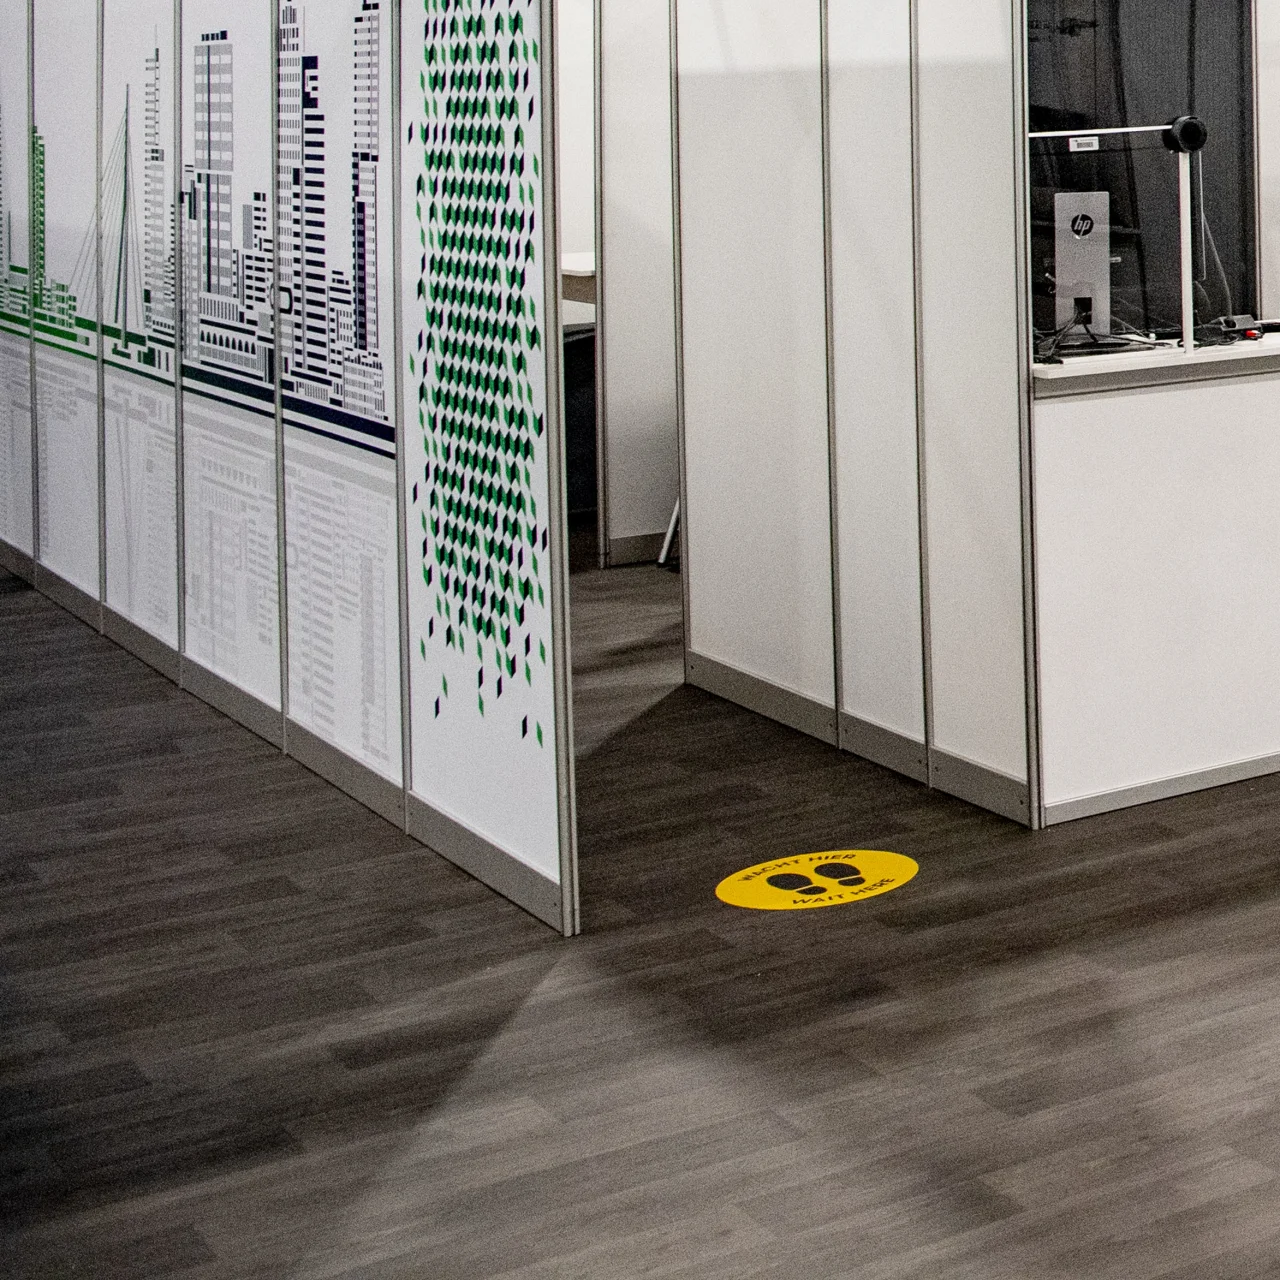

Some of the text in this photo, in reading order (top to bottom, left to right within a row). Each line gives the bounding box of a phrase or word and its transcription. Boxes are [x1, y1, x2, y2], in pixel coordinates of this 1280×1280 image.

[808, 853, 856, 862] HIER
[792, 878, 896, 904] WAIT HERE
